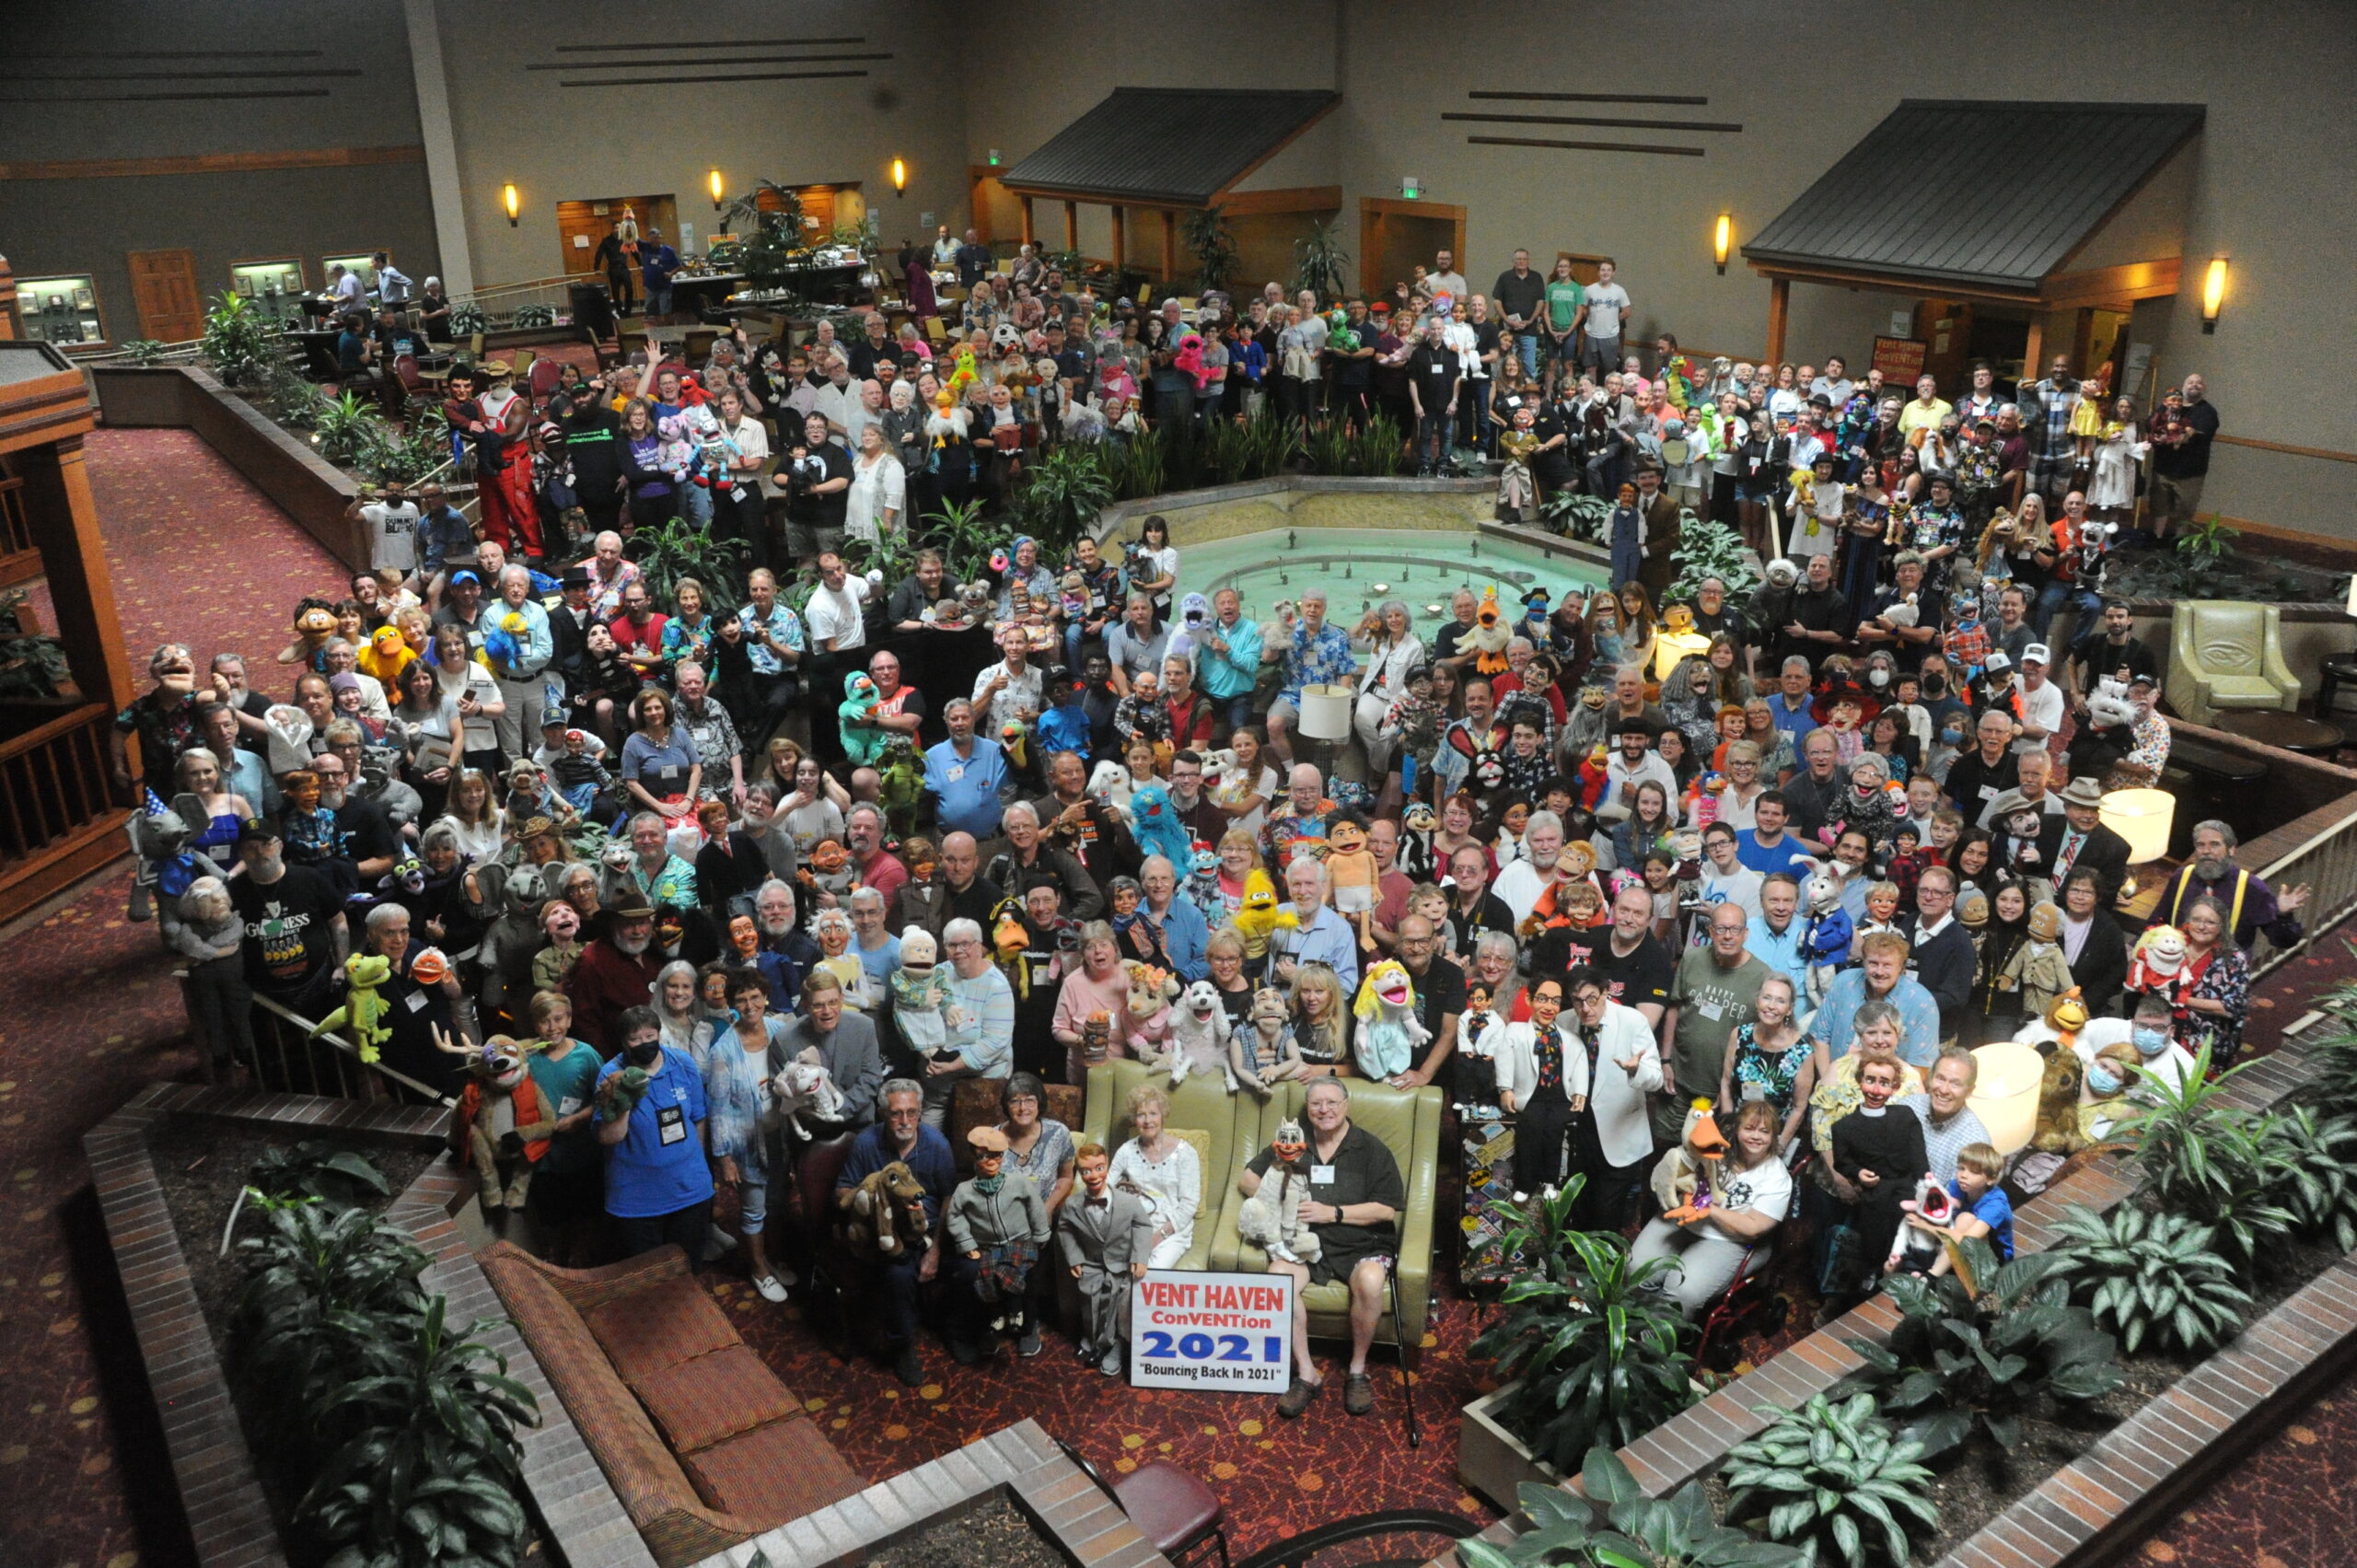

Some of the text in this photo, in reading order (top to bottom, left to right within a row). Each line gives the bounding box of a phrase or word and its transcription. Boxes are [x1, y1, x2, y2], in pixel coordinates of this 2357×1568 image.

[245, 912, 310, 937] GNESS
[1705, 984, 1735, 1000] HAPPY
[1140, 1282, 1283, 1312] VENT HAVEN
[1151, 1311, 1271, 1329] ConVENTion
[1141, 1330, 1282, 1363] 2021
[1140, 1364, 1282, 1381] "Bouncing Back In 2021"
